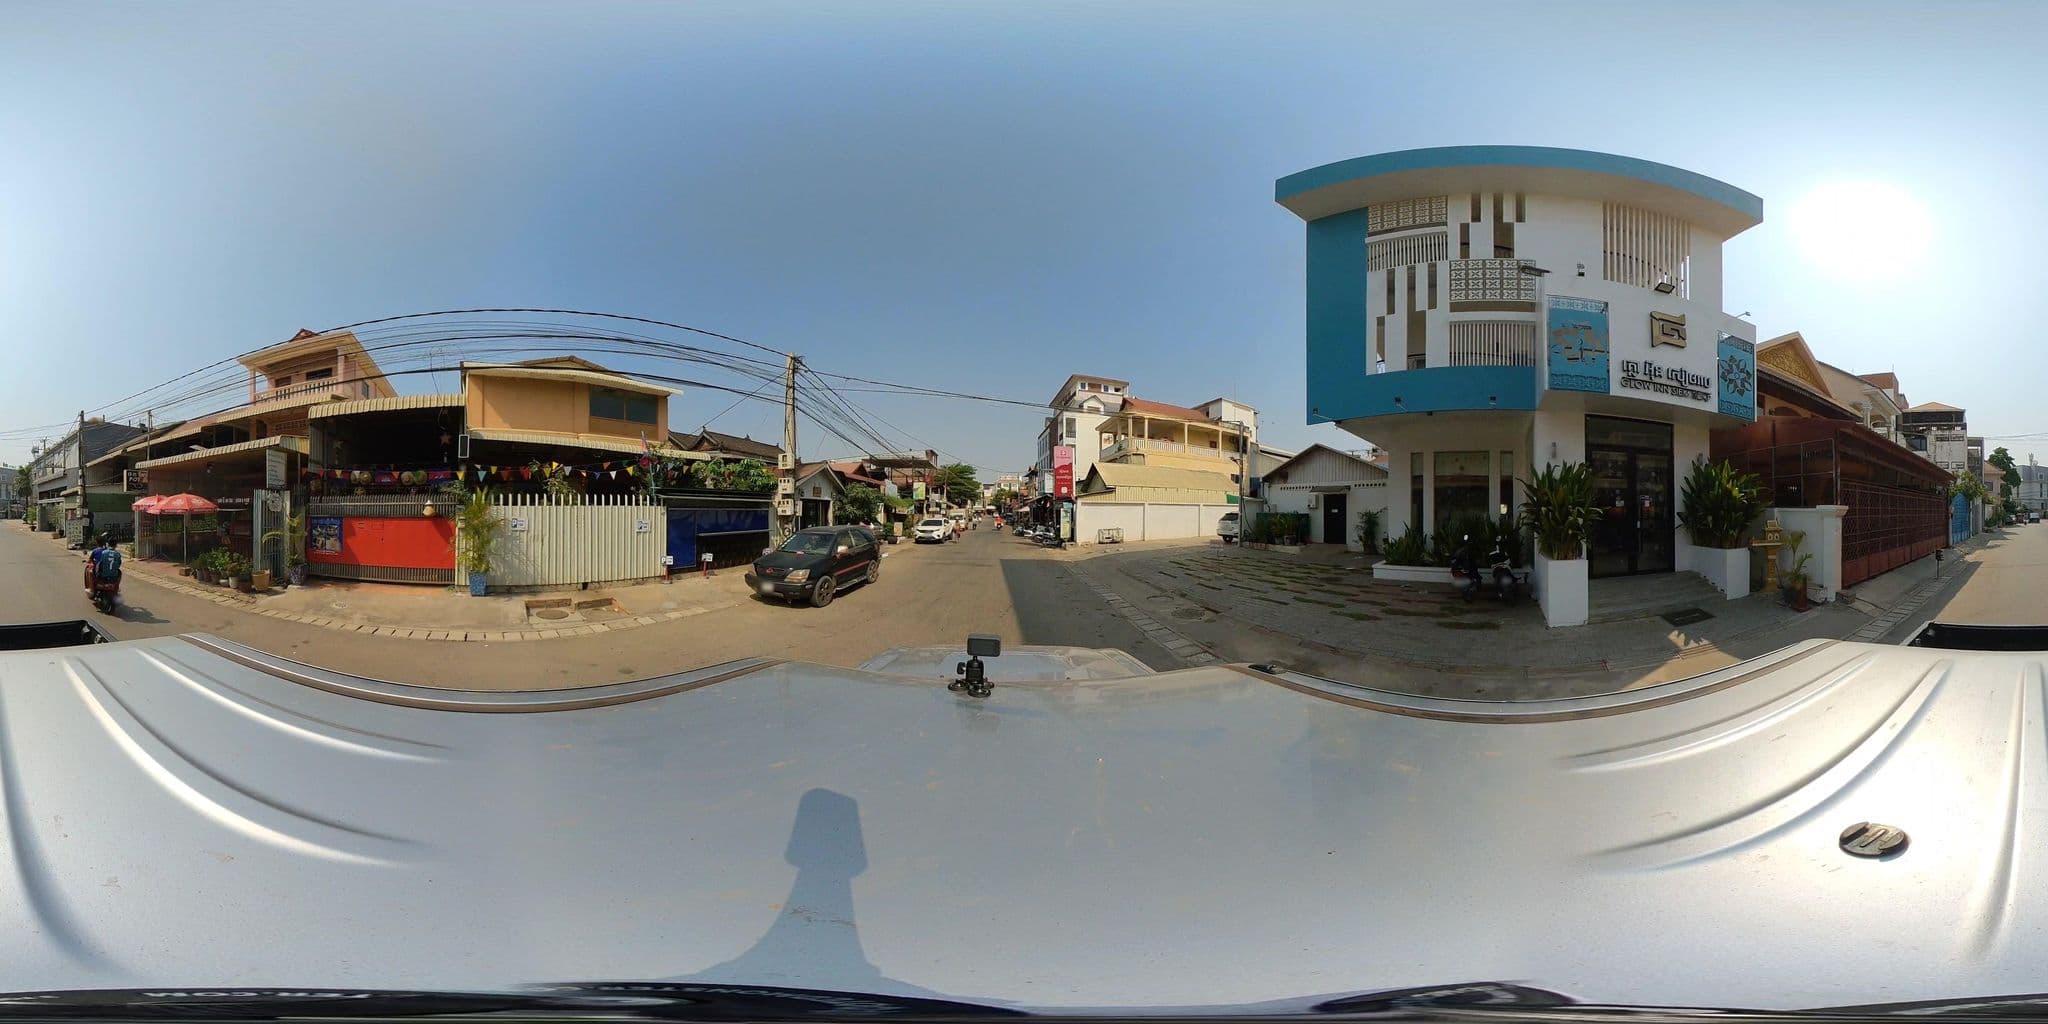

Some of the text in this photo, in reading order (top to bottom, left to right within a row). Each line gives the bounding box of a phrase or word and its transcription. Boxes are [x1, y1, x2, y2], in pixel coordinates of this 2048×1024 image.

[1621, 377, 1652, 390] GLOW
[1653, 382, 1670, 394] INN
[108, 557, 115, 570] 7
